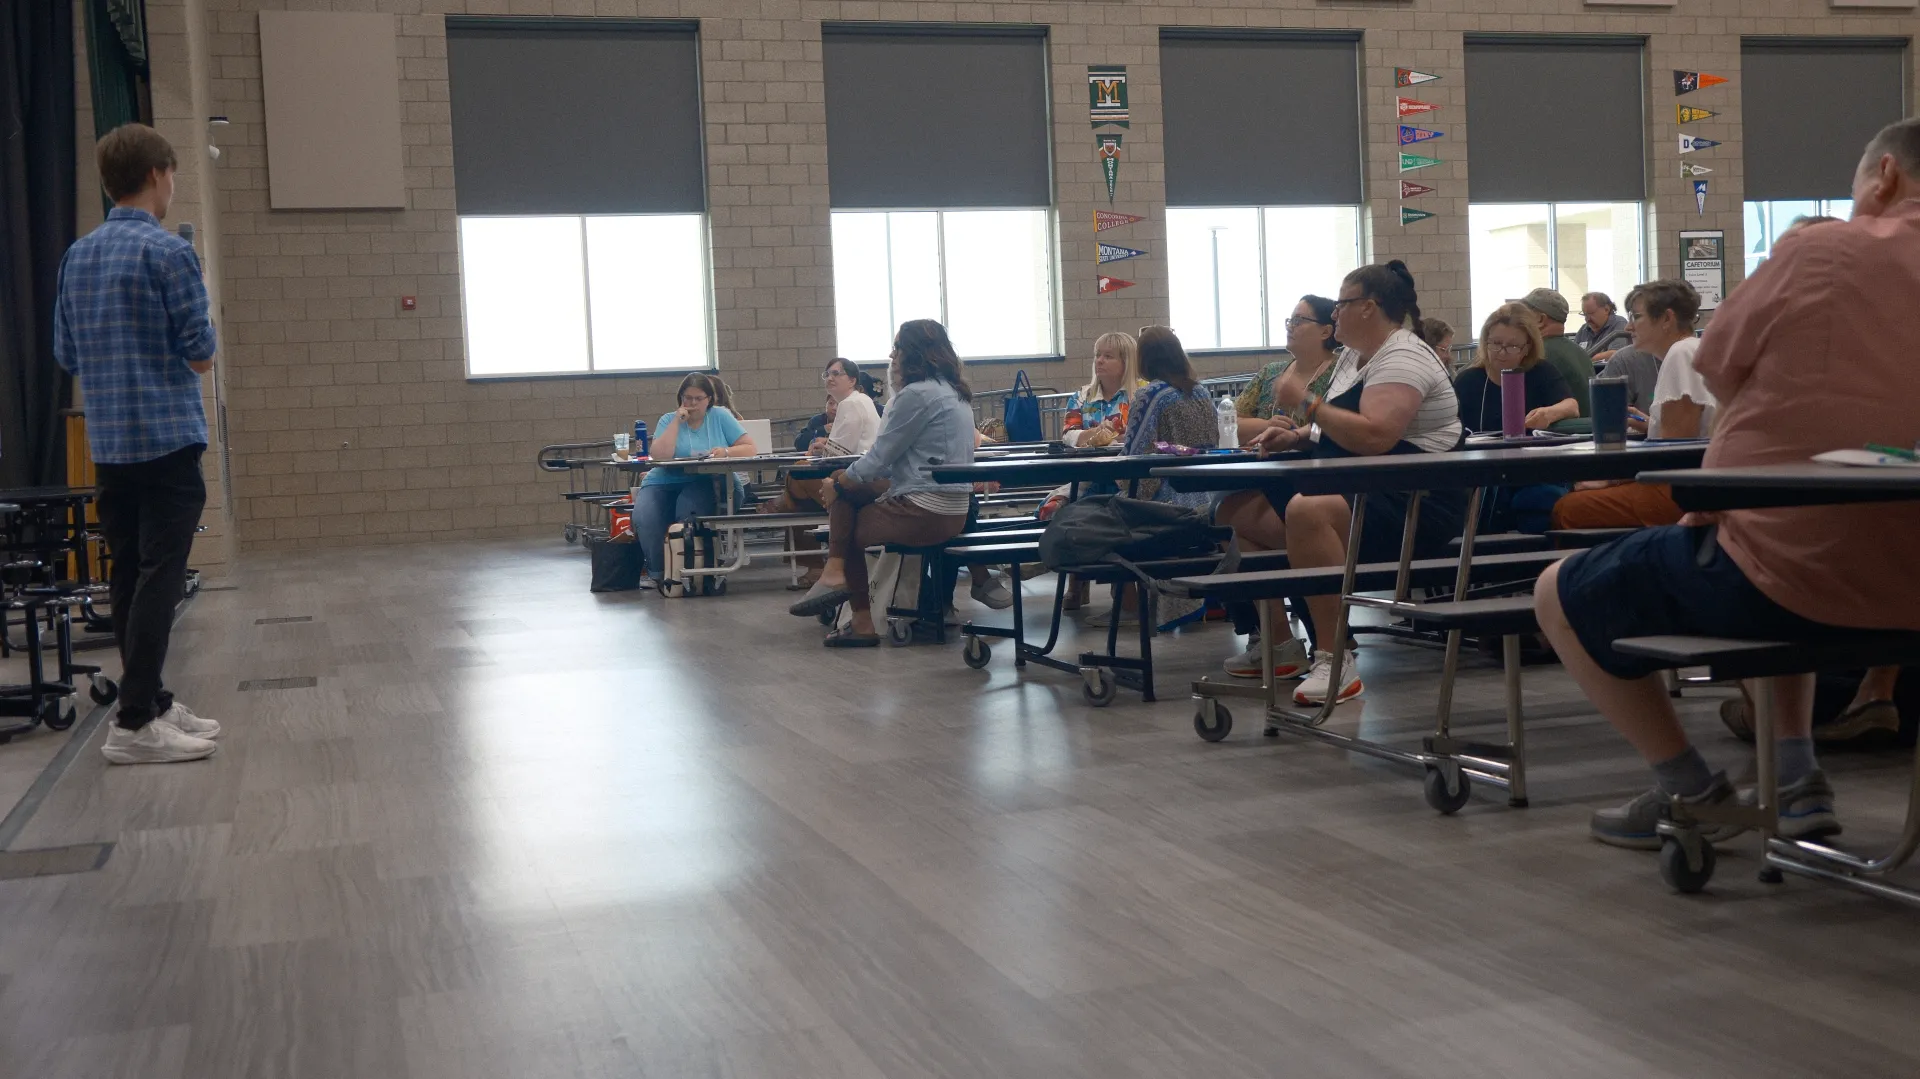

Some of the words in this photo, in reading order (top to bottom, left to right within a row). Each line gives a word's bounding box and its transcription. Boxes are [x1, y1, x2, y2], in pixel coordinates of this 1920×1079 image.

[1683, 139, 1690, 149] D
[1096, 212, 1128, 220] CONCORDIA
[1097, 220, 1129, 231] COLLEGE
[1098, 244, 1129, 256] MONTANA
